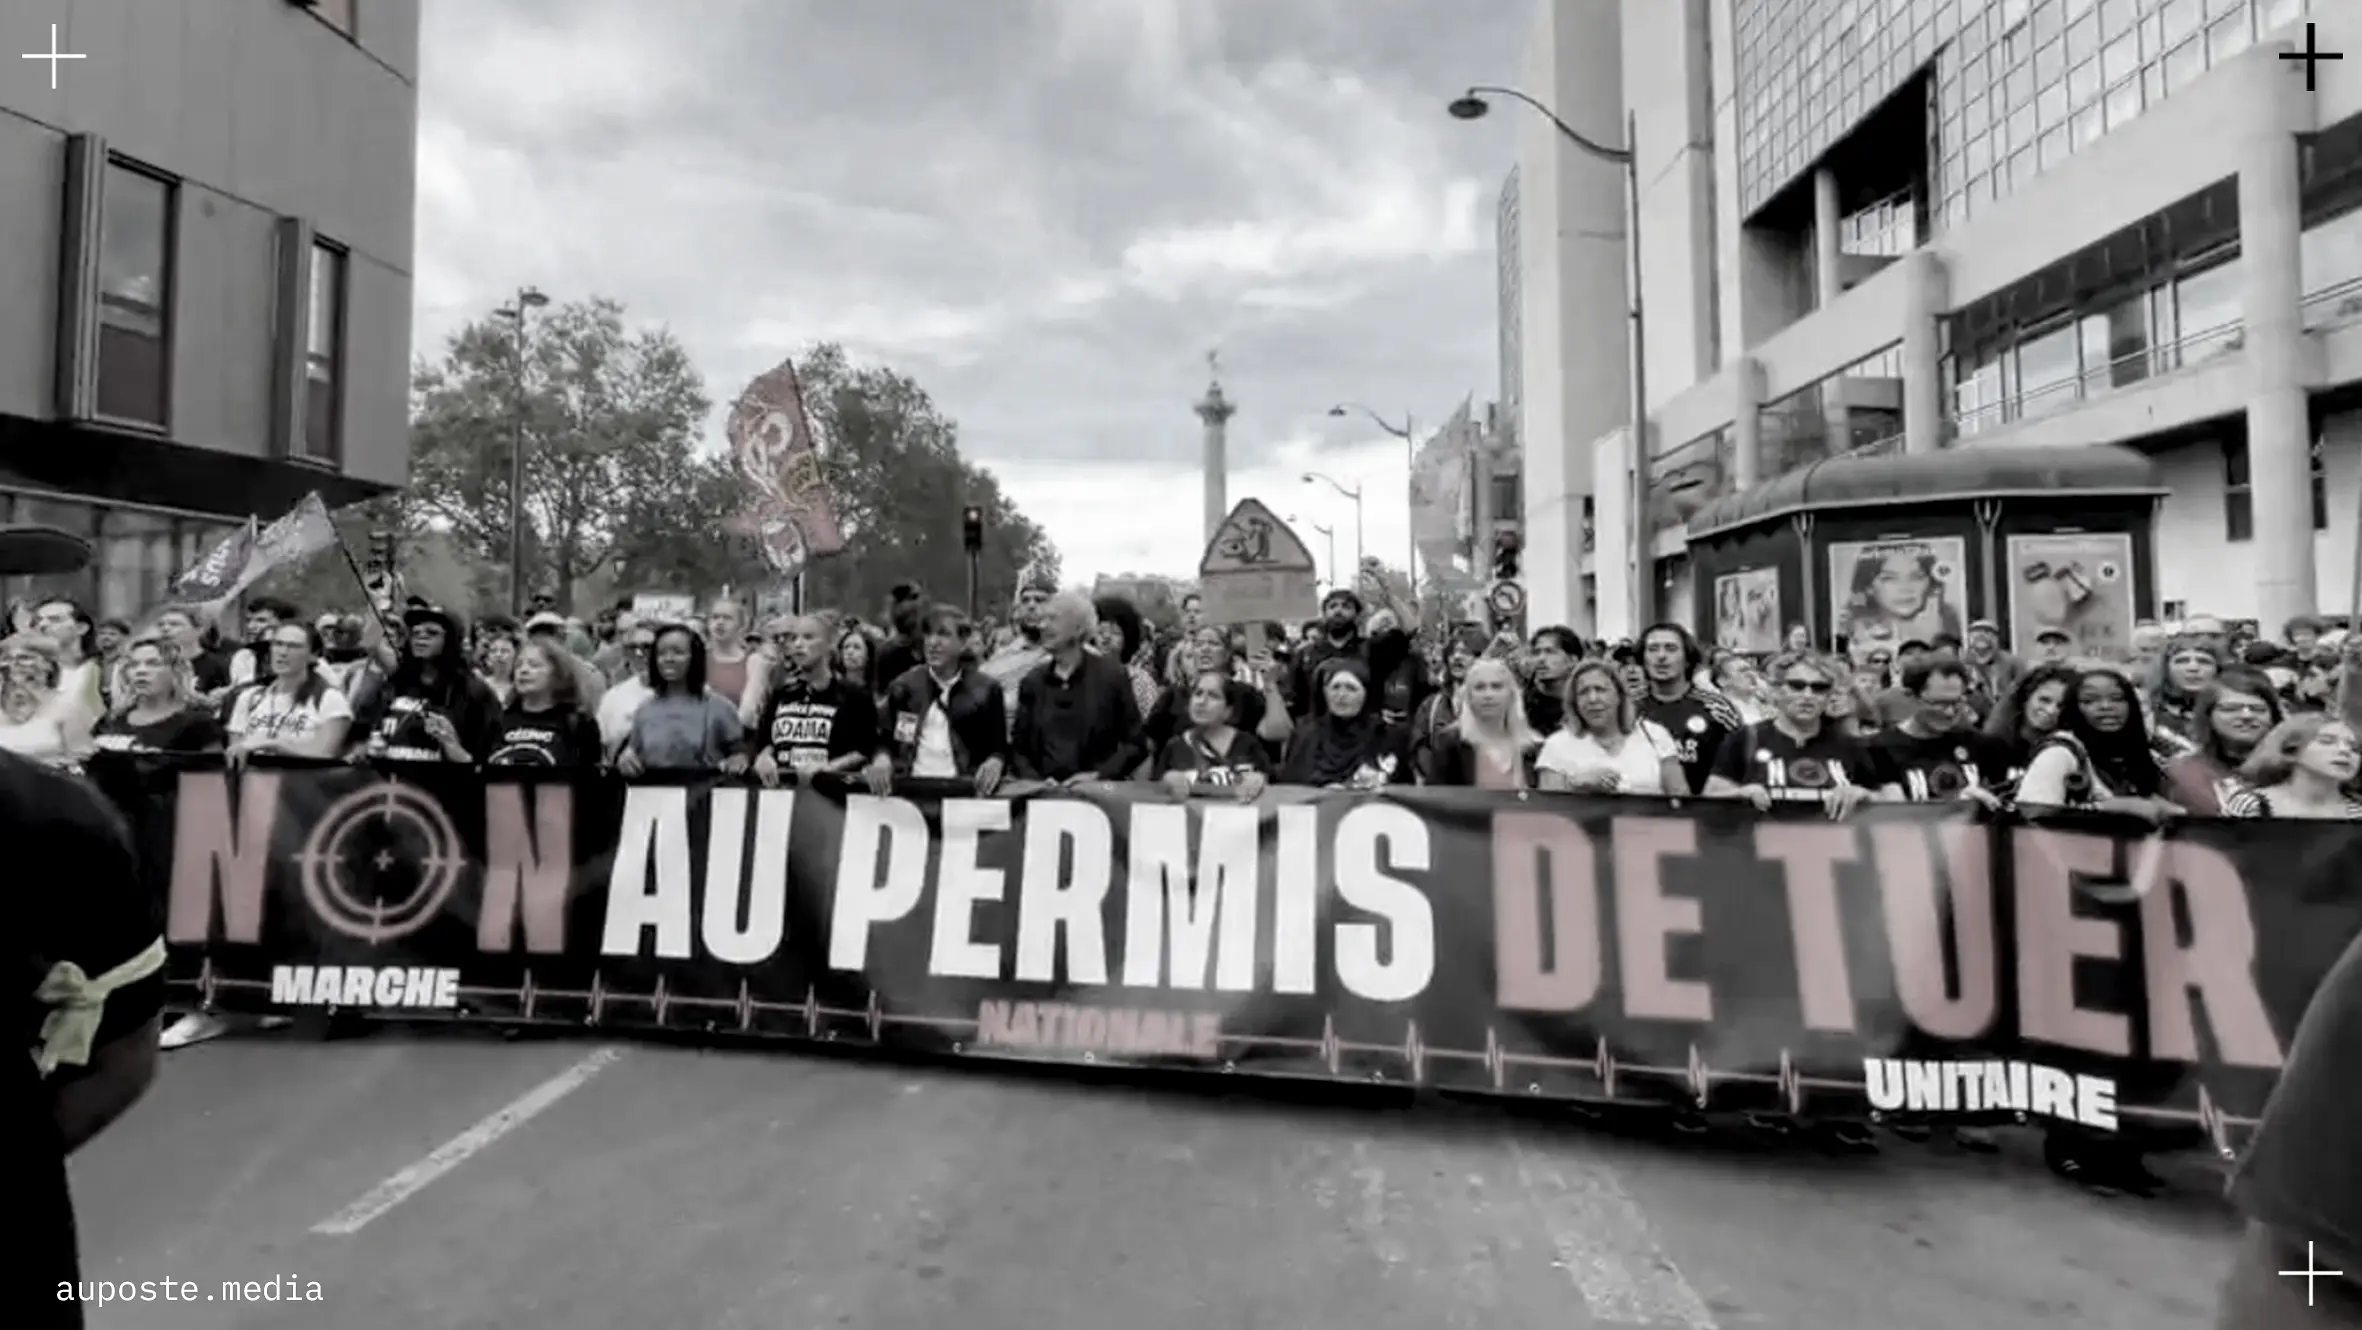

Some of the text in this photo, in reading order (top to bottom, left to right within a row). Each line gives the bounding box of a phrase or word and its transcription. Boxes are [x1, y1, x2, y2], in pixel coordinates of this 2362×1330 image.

[167, 772, 2287, 1069] NON AU PERMIS DE TUER
[271, 965, 2119, 1132] MARCHE NATIONALE UNITAIRE
